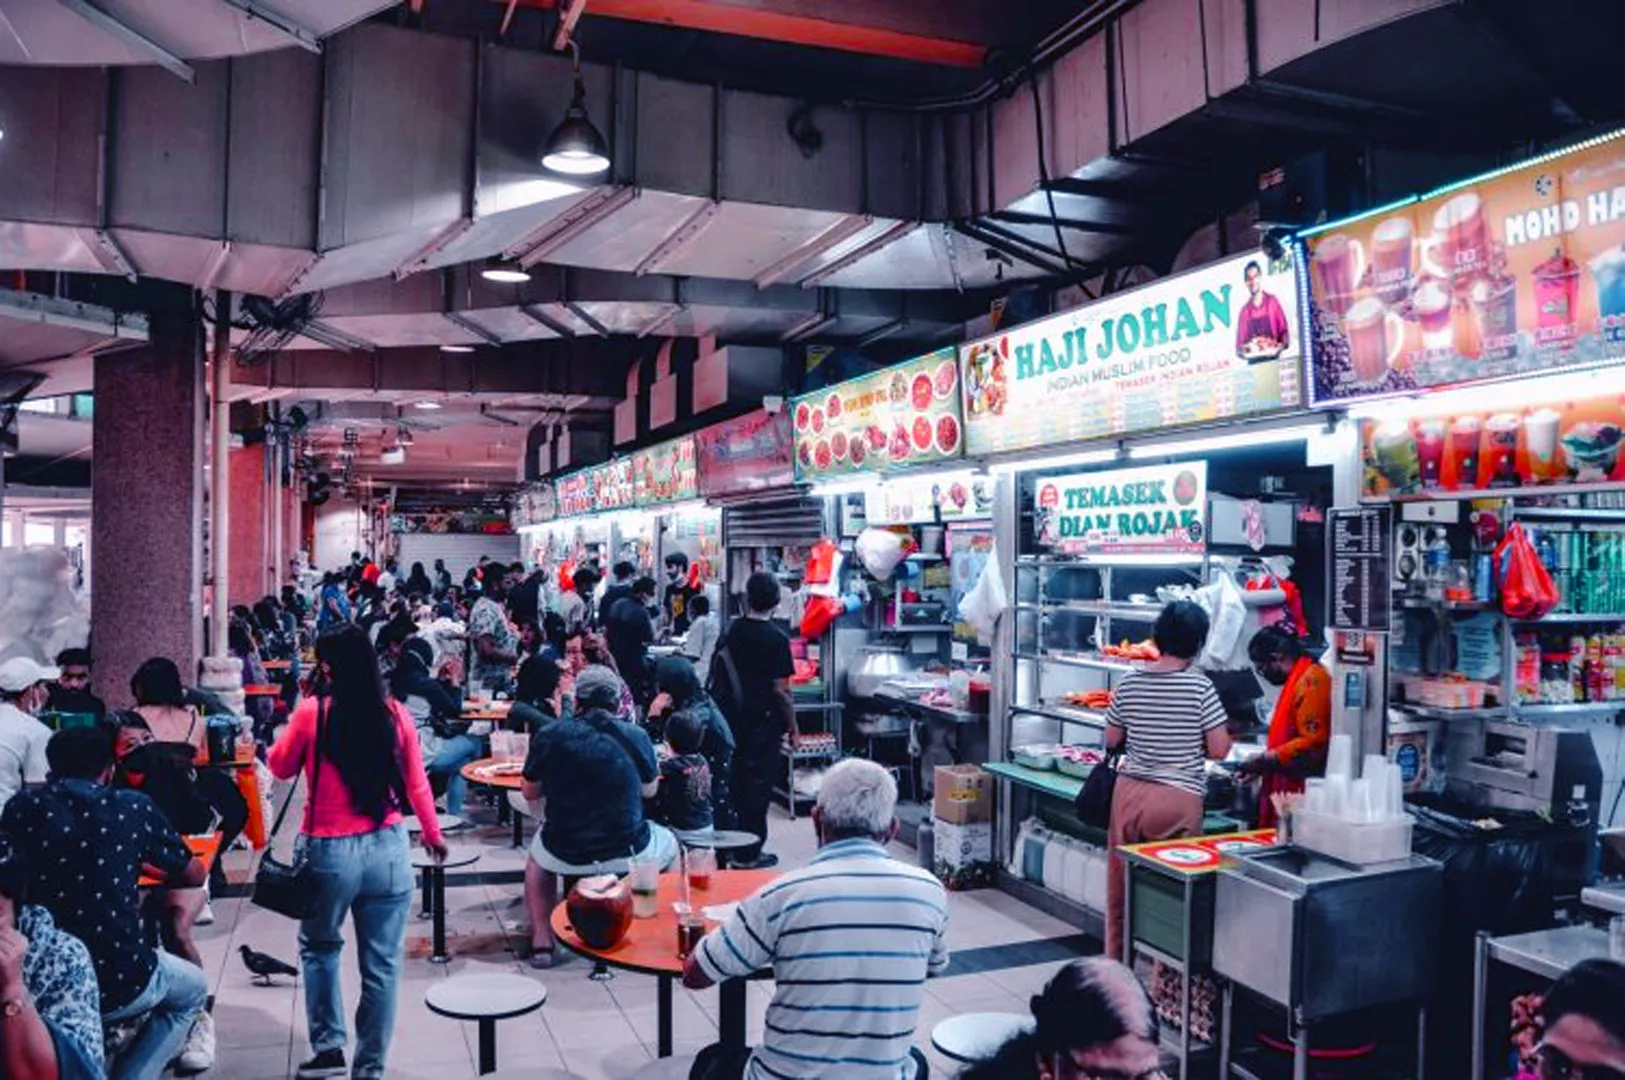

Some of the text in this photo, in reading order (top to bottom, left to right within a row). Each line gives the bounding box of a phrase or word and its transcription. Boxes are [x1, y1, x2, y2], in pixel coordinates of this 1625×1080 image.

[1506, 202, 1580, 245] MOHD
[1015, 284, 1232, 380] HAJI JOHAN
[1047, 347, 1191, 392] INDIAN MUSLIM FOOD
[1064, 481, 1167, 509] TEMASEK
[1059, 514, 1112, 537] DIAN
[1117, 509, 1198, 537] ROJAK
